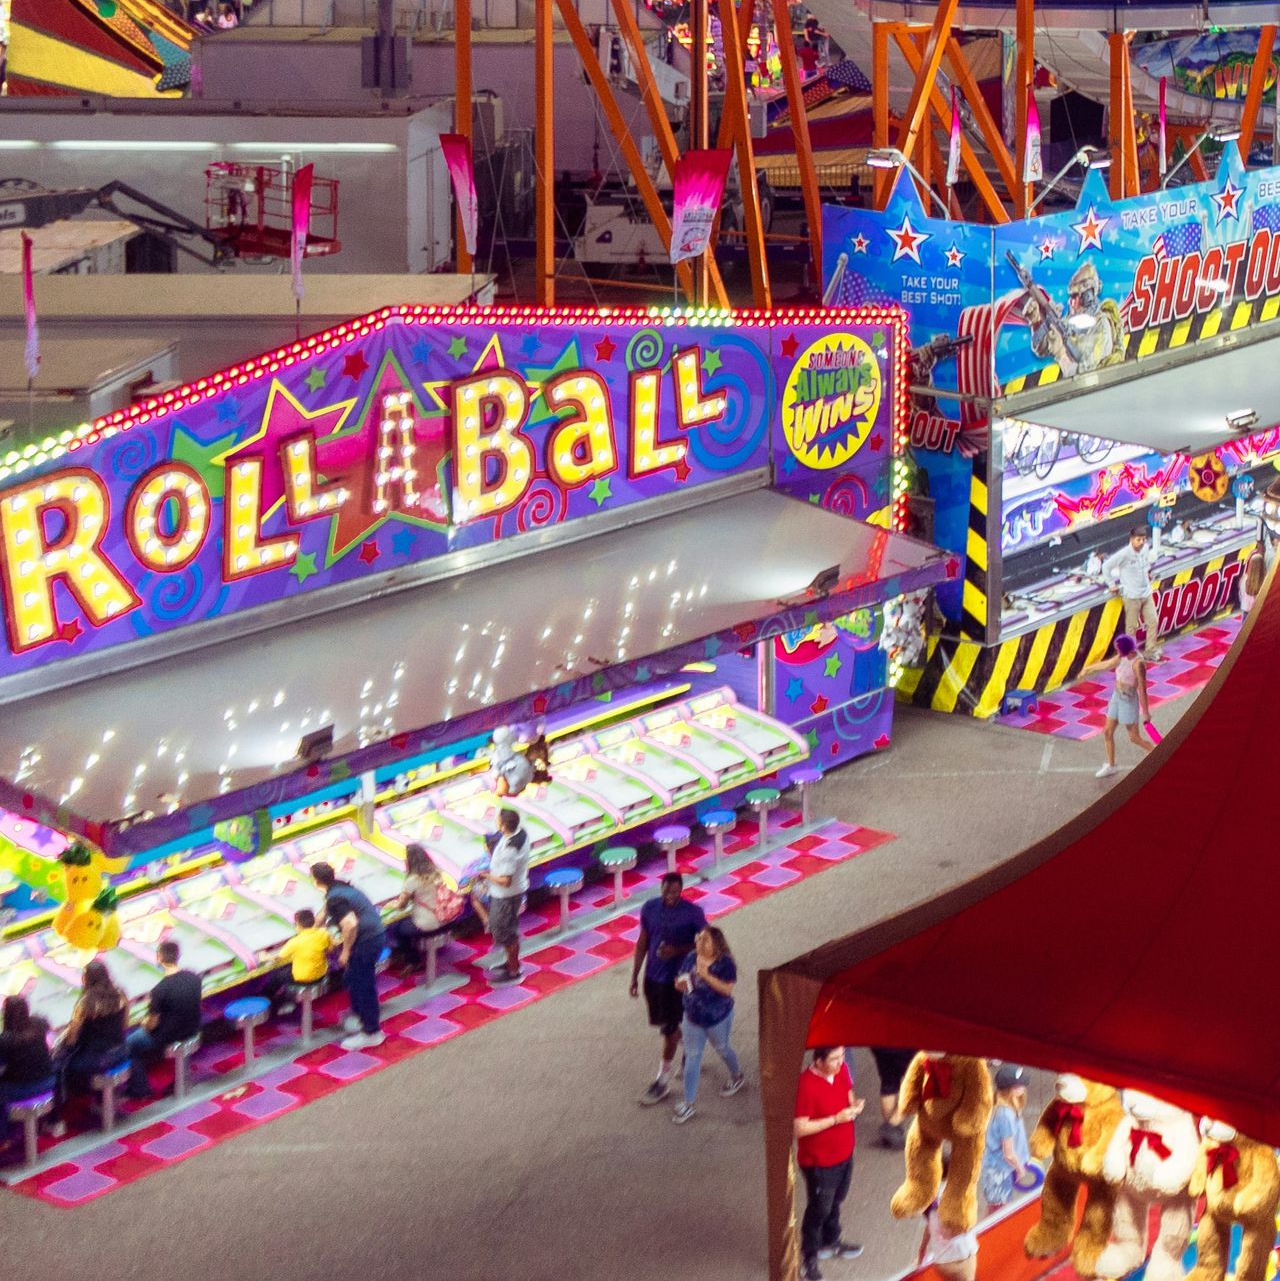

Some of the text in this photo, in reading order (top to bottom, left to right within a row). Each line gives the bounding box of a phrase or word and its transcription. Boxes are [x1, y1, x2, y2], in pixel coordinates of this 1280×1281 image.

[1214, 60, 1277, 99] WID
[1120, 210, 1156, 230] TAKE
[1160, 199, 1198, 223] YOUR
[901, 275, 959, 290] TAKE YOUR
[901, 290, 961, 305] BEST SHOT!
[1127, 238, 1250, 333] SHOOT
[808, 349, 865, 369] SOMEONE
[796, 362, 873, 404] Always
[792, 378, 878, 451] WINS
[911, 410, 962, 454] OUT
[0, 429, 351, 656] ROLL
[370, 389, 420, 515] A
